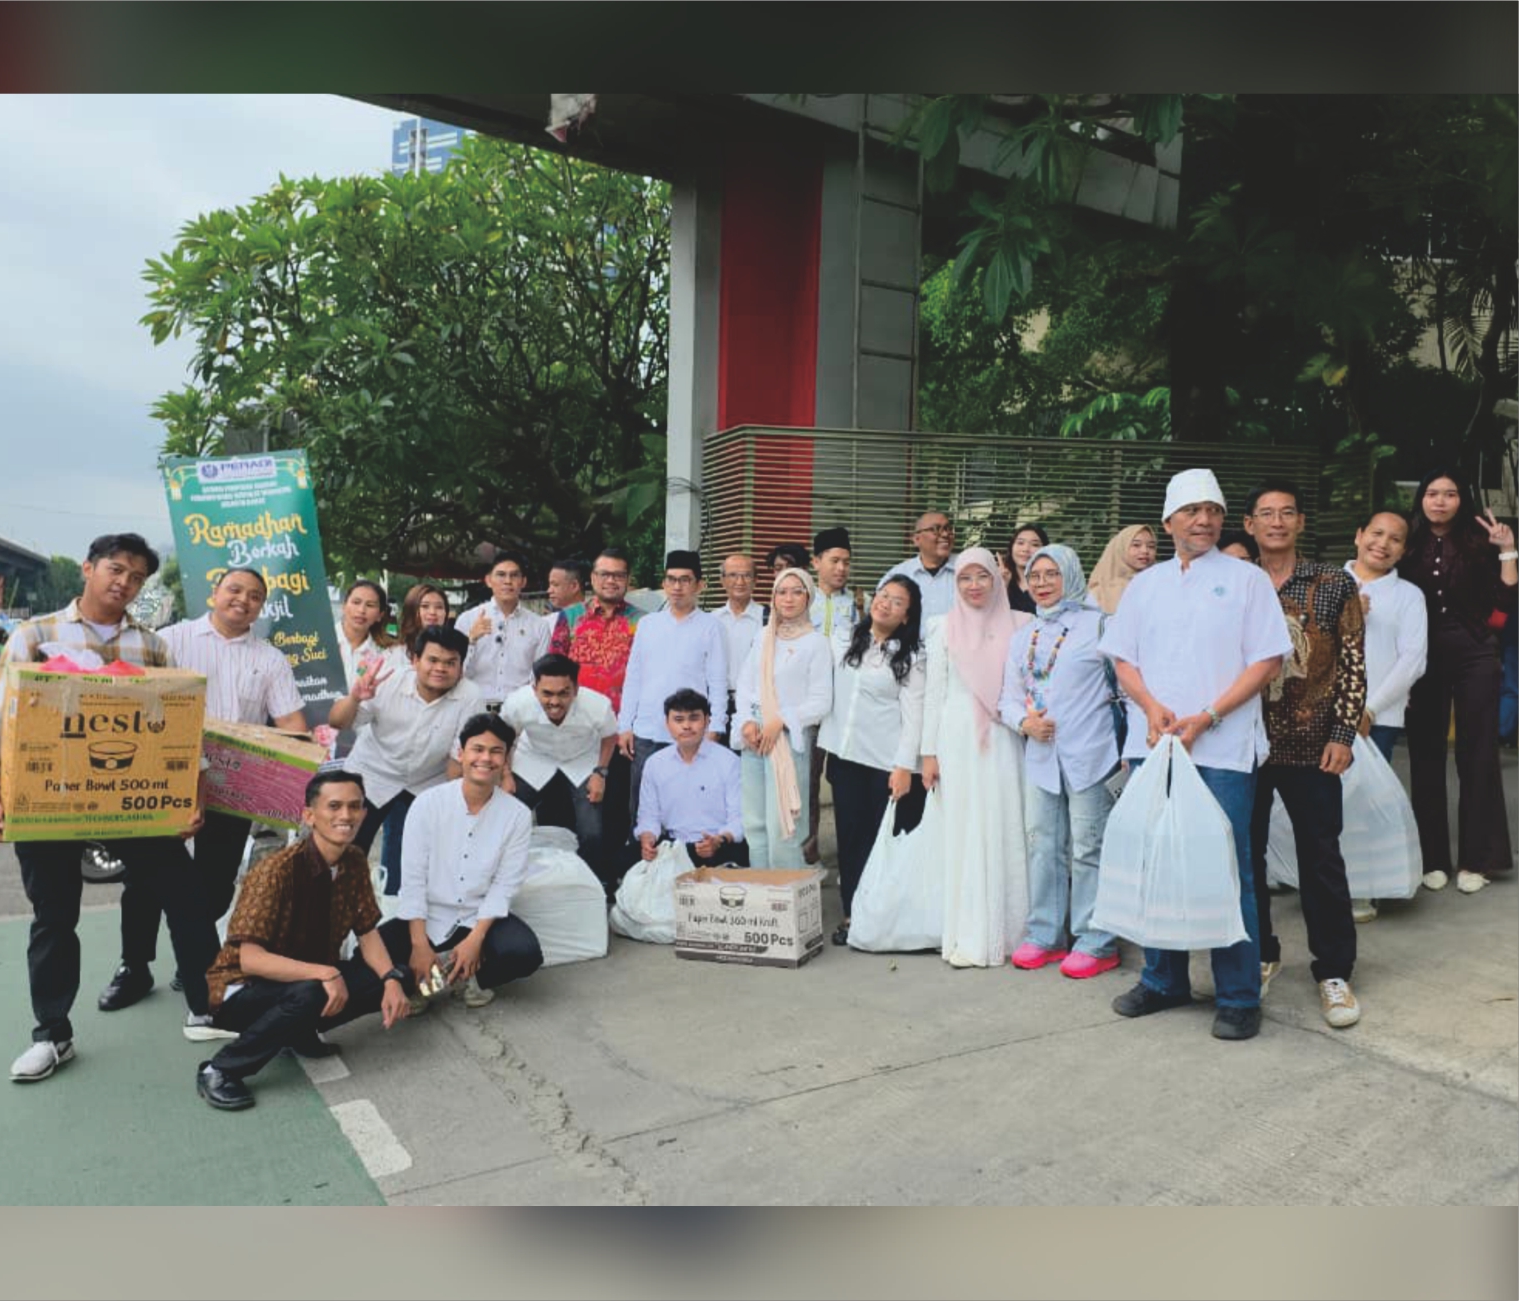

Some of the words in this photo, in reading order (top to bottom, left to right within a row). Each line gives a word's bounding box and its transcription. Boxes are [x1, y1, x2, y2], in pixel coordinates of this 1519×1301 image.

[184, 511, 308, 547] Ramadhan
[227, 534, 300, 567] Berkah
[274, 630, 320, 646] Berbagi
[301, 647, 327, 663] Suci
[45, 779, 81, 792] Paer
[86, 778, 116, 791] Bowl
[119, 779, 149, 791] 500
[152, 778, 169, 790] ml
[121, 796, 157, 811] 500
[160, 795, 193, 810] Pcs
[744, 932, 768, 945] 500
[771, 933, 794, 946] Pcs
